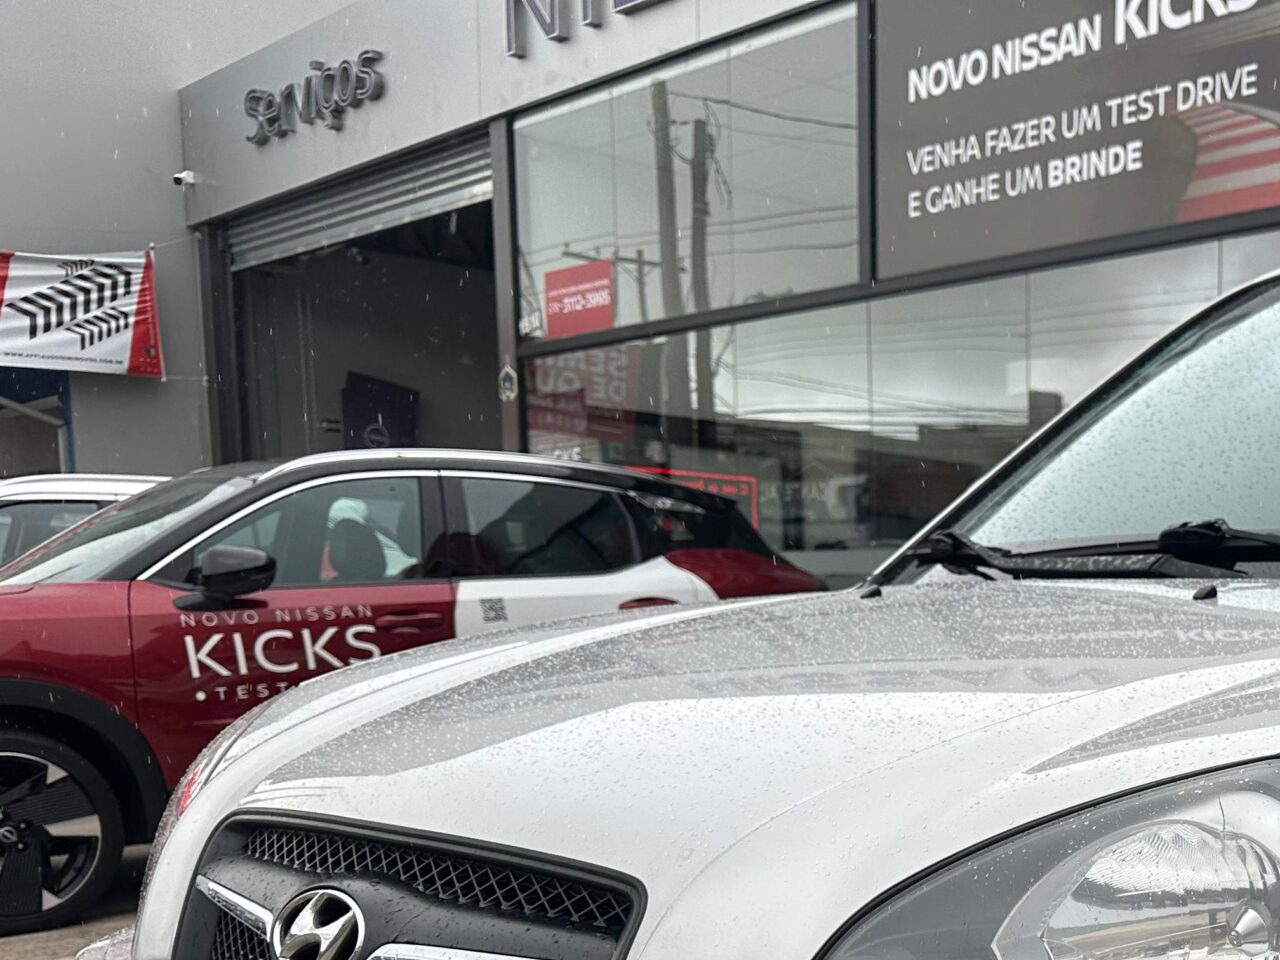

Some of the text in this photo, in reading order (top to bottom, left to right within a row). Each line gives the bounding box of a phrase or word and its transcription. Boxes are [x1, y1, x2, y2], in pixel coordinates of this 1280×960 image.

[908, 49, 988, 102] NOVO
[992, 14, 1101, 79] NISSAN
[906, 64, 1258, 175] VENHA FAZER UM TEST DRIVE
[908, 140, 1144, 218] E GANHE UM BRINDE
[179, 604, 373, 628] NOVO NISSAN
[184, 624, 381, 680] KICKS
